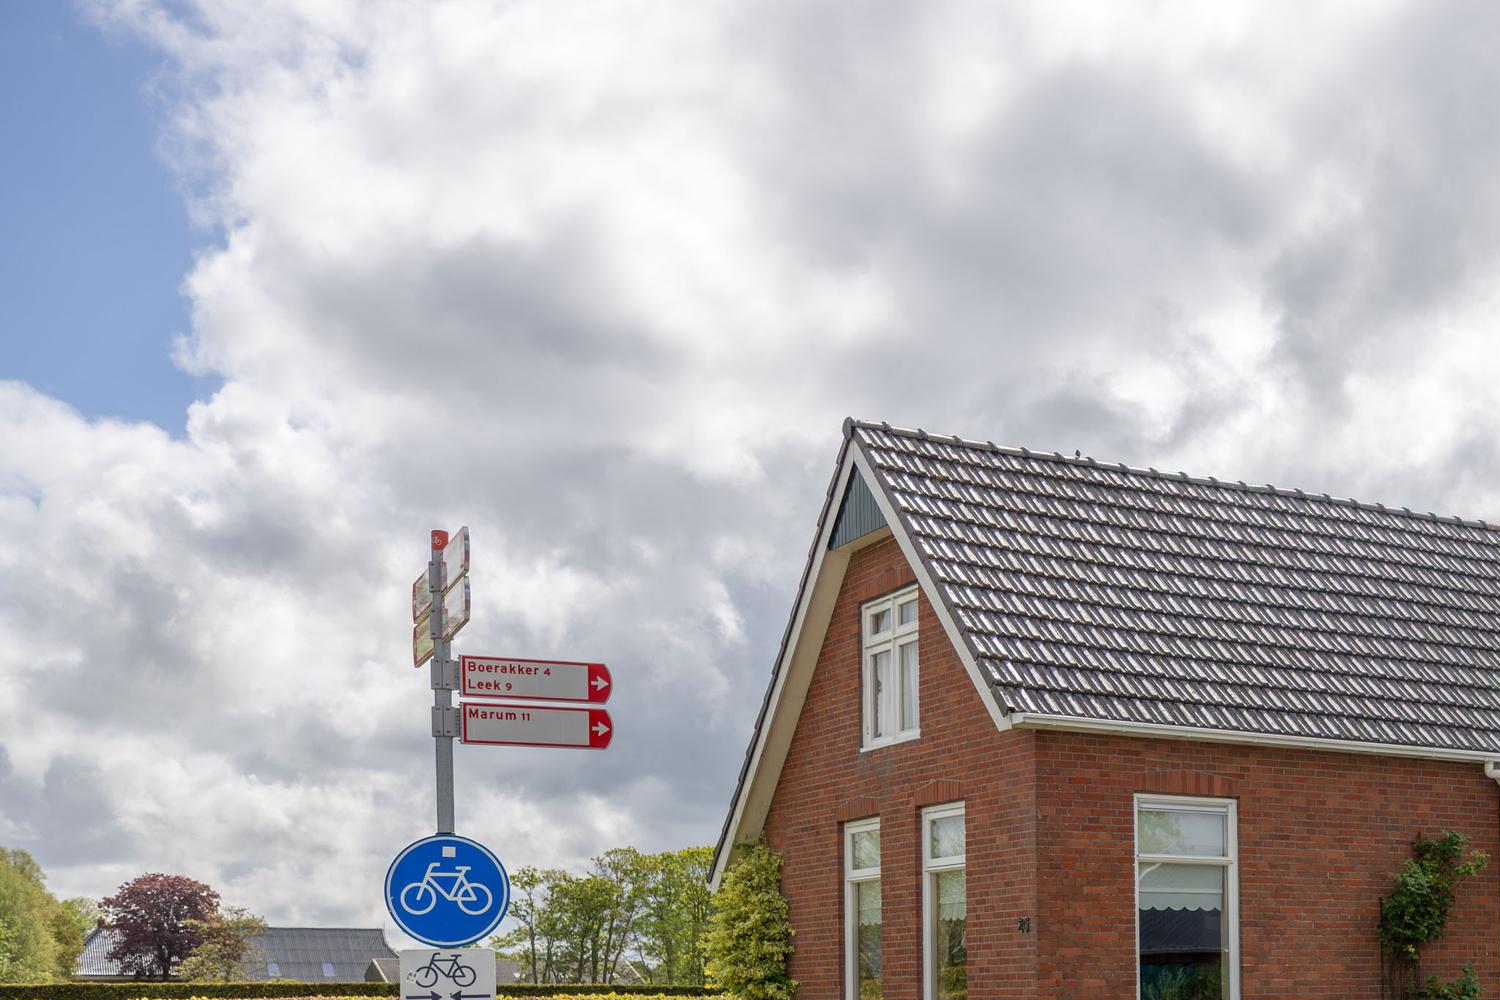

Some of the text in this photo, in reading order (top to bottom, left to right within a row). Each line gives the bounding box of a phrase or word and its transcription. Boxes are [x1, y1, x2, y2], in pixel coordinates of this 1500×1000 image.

[467, 661, 552, 677] Boerakker 4
[467, 678, 513, 691] Leek 9
[468, 708, 531, 722] Marum 11
